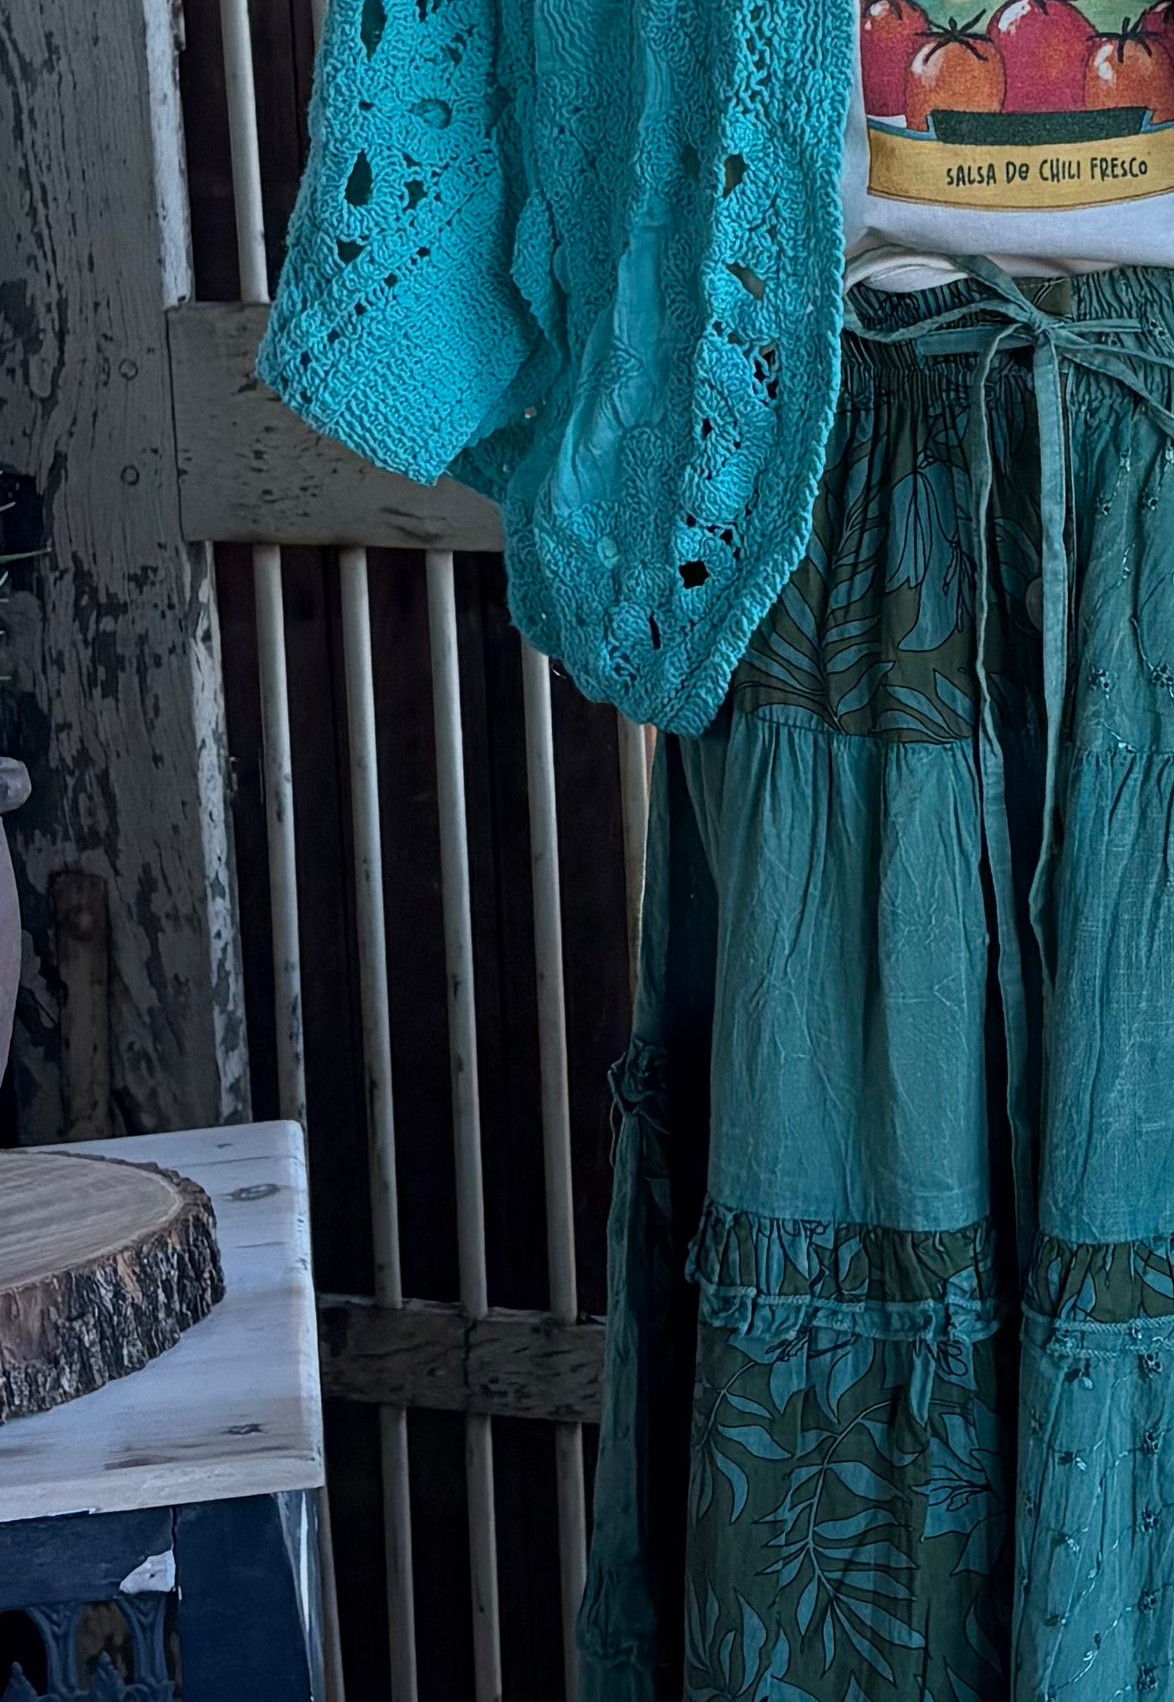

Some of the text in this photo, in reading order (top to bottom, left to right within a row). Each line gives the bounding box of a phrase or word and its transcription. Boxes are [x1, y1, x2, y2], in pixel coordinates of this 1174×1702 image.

[946, 162, 998, 188] SALSA
[1039, 157, 1082, 184] CHILI
[1090, 156, 1149, 183] FRESCO
